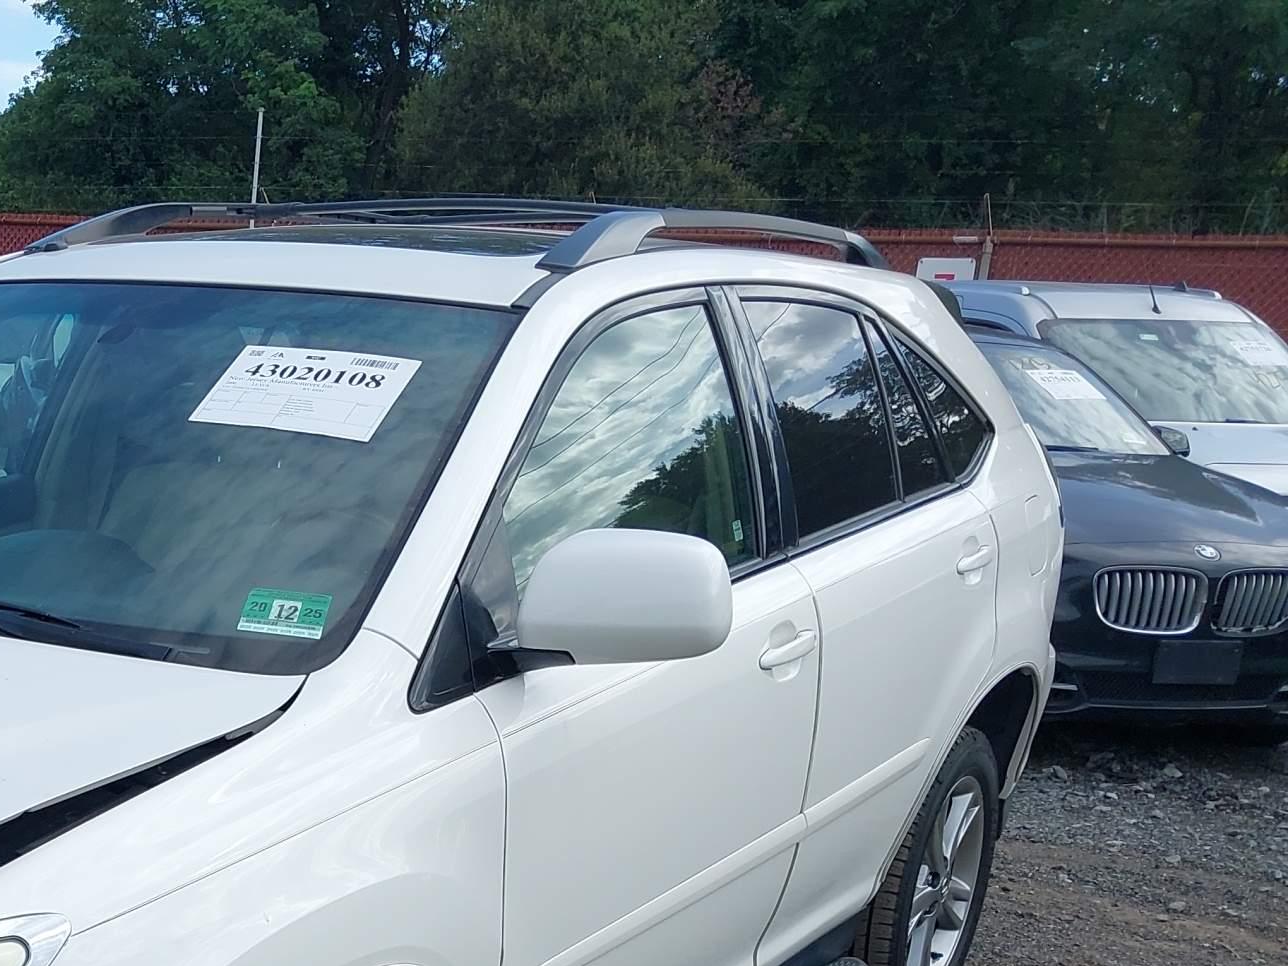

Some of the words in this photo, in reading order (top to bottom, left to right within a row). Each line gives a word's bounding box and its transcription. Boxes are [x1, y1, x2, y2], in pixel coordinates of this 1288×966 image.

[244, 362, 386, 390] 43020108
[248, 601, 268, 613] 20
[274, 603, 299, 621] 12
[303, 607, 324, 619] 25
